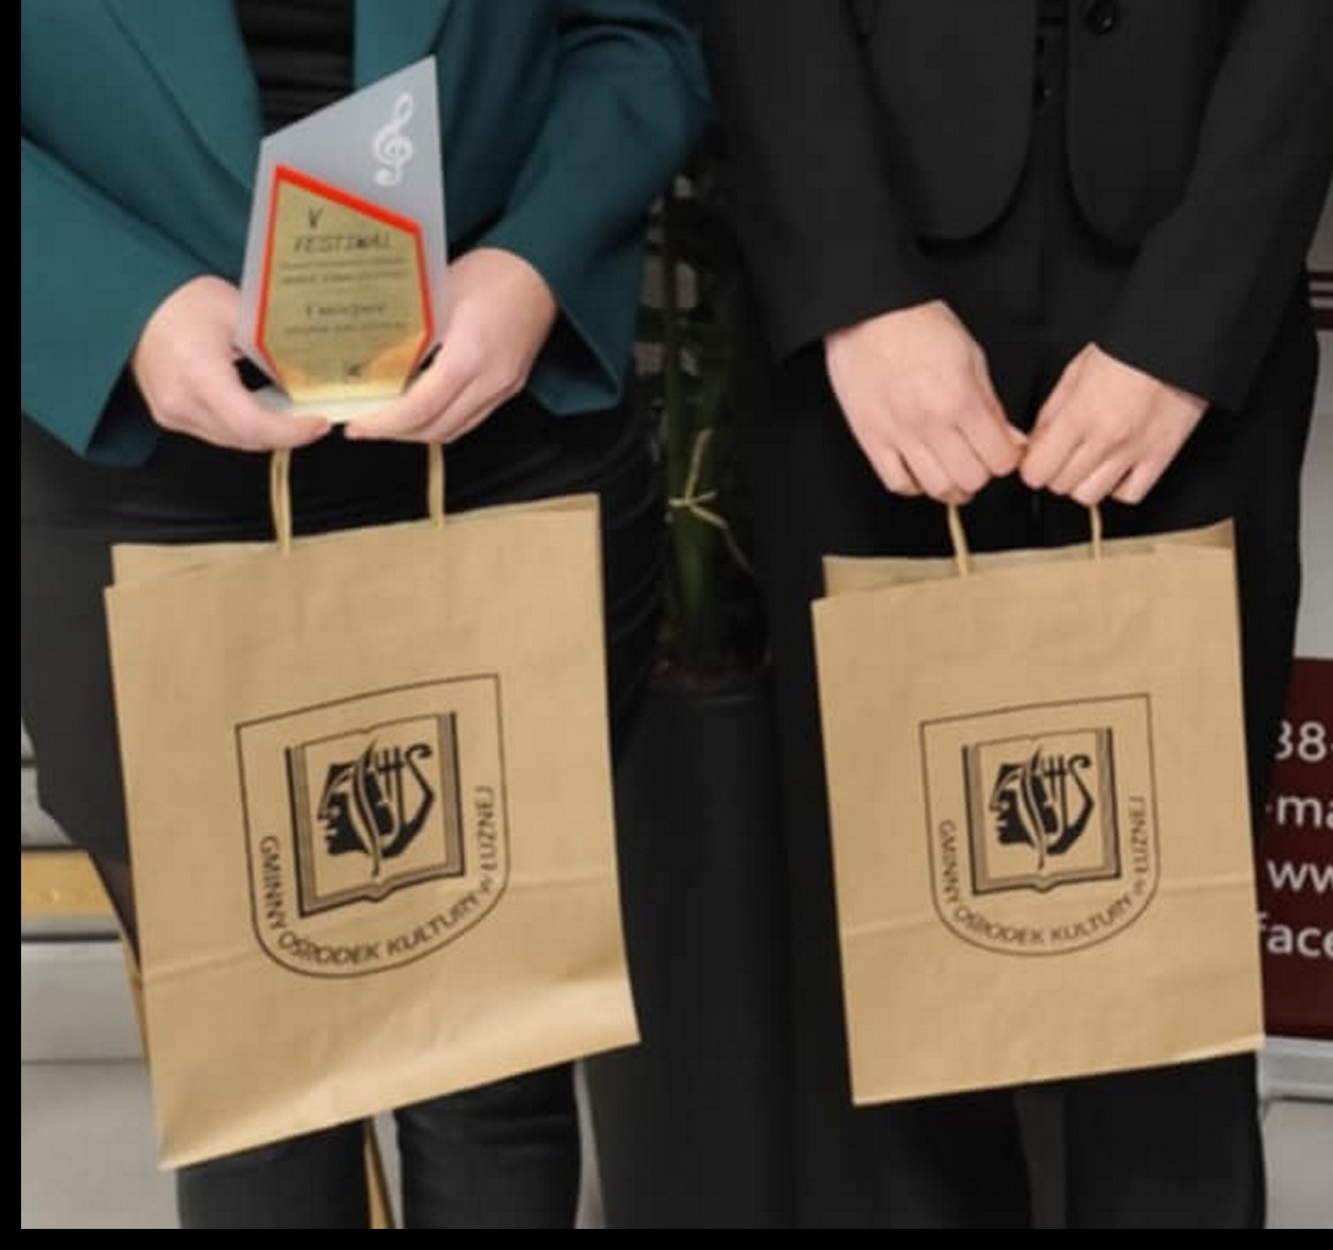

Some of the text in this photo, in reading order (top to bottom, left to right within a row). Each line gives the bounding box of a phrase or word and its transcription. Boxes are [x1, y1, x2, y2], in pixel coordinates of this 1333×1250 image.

[259, 835, 287, 930] GMINNY
[386, 893, 481, 956] KULTURY
[1051, 894, 1134, 942] KULTURY
